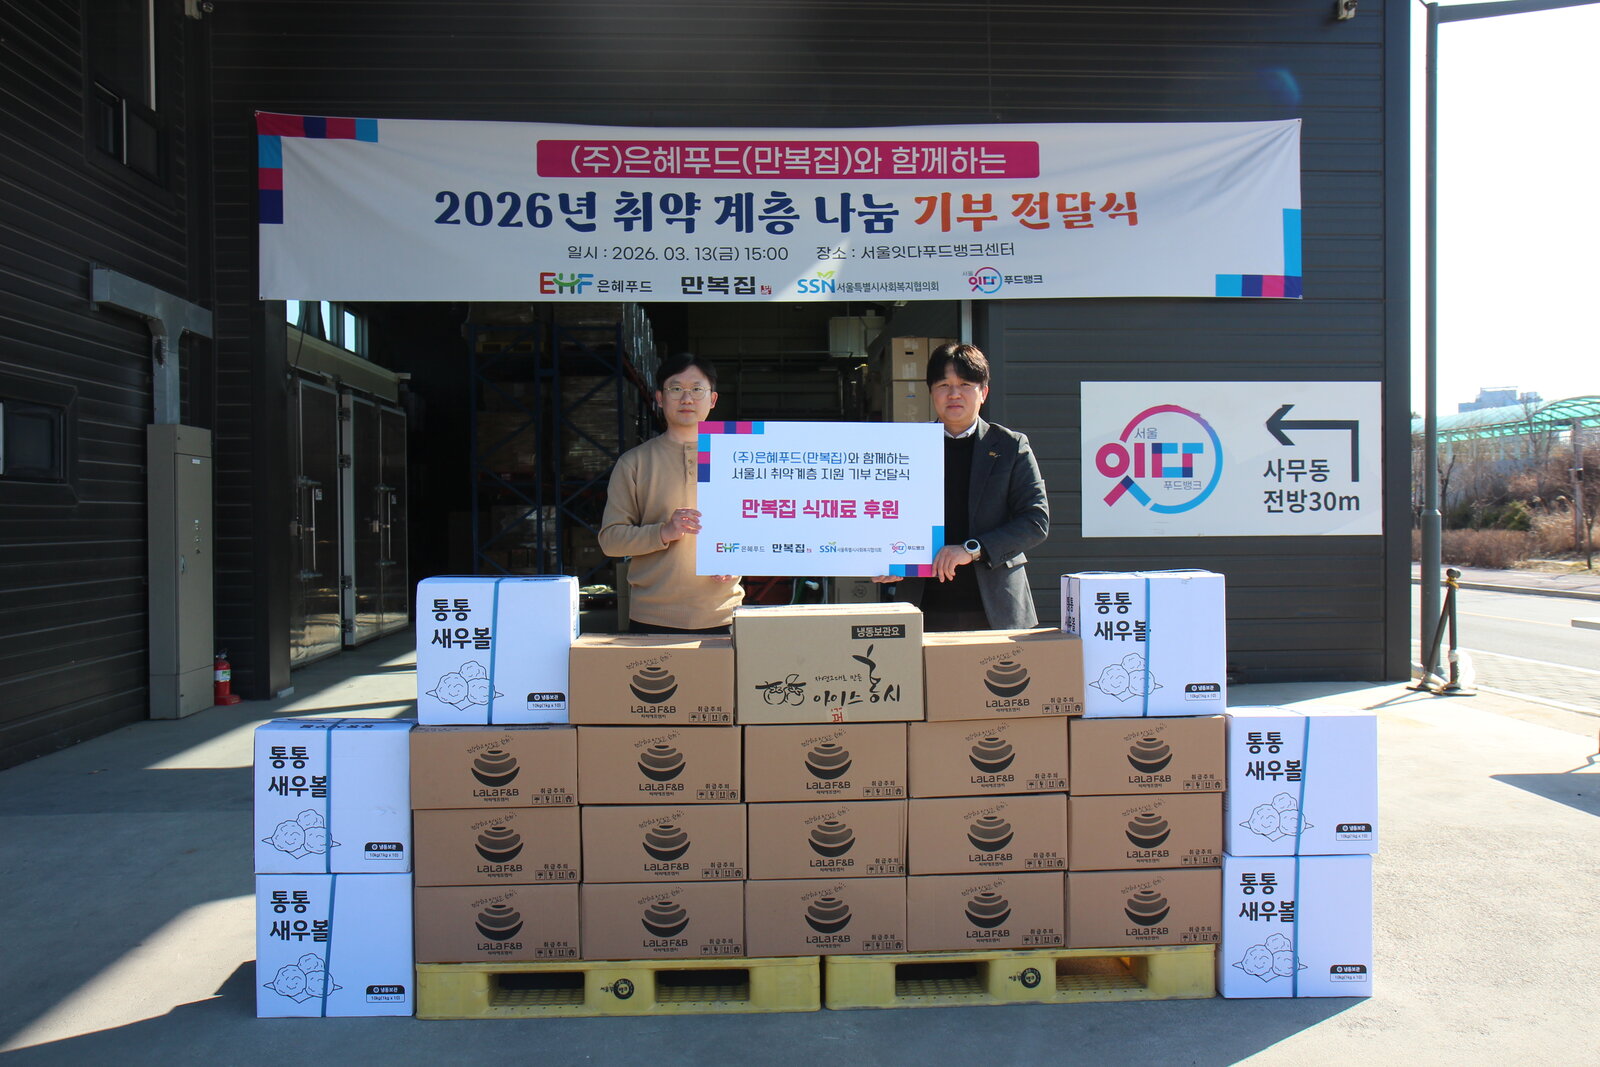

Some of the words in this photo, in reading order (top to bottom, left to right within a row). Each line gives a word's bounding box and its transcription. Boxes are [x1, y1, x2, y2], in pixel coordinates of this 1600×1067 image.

[571, 146, 882, 175] (주)은혜푸드(만복집)와
[892, 147, 1006, 175] 함께하는
[434, 191, 596, 232] 2026년
[614, 191, 701, 233] 취약
[714, 191, 800, 235] 계층
[815, 193, 899, 233] 나눔
[914, 192, 997, 232] 기부
[1011, 192, 1138, 230] 전달식
[568, 246, 597, 259] 일시
[613, 247, 658, 261] 2026.
[664, 247, 689, 261] 03.
[696, 247, 739, 261] 13(금)
[745, 247, 788, 261] 15:00
[817, 247, 847, 260] 장소
[861, 242, 1015, 260] 서울잇다푸드뱅크센터
[540, 272, 594, 294] EHF
[681, 276, 756, 295] 만복집
[797, 278, 836, 294] SSN
[1004, 274, 1043, 284] 푸드뱅크
[597, 280, 653, 294] 은혜푸드
[837, 281, 939, 293] 서울특별시사회복지협의회
[1134, 428, 1157, 439] 서울
[733, 451, 859, 465] (주)은혜푸드(만복집)와
[863, 452, 909, 465] 함께하는
[732, 467, 767, 480] 서울시
[771, 468, 817, 480] 취약계층
[821, 468, 844, 480] 지원
[850, 468, 871, 480] 기부
[875, 468, 910, 480] 전달식
[1263, 459, 1330, 482] 사무동
[1163, 480, 1202, 490] 푸드뱅크
[742, 499, 796, 519] 만복집
[803, 499, 857, 519] 식재료
[864, 499, 899, 519] 후원
[1263, 490, 1360, 514] 전방30m
[772, 543, 805, 553] 만복집
[820, 545, 837, 553] SSN
[432, 599, 471, 621] 통통
[1094, 592, 1132, 614] 통통
[1094, 620, 1151, 642] 새우볼
[432, 628, 492, 650] 새우볼
[631, 706, 656, 714] LaLa
[657, 706, 676, 714] F&B
[986, 698, 1010, 708] LaLa
[1012, 698, 1030, 706] F&B
[1246, 732, 1283, 754] 통통
[269, 746, 309, 768] 통통
[1246, 760, 1302, 781] 새우볼
[806, 782, 831, 790] LaLa
[833, 781, 850, 789] F&B
[971, 775, 995, 783] LaLa
[997, 774, 1015, 782] F&B
[268, 776, 326, 798] 새우볼
[473, 789, 499, 797] LaLa
[501, 788, 519, 796] F&B
[666, 783, 684, 791] F&B
[809, 859, 835, 868] LaLa
[836, 858, 854, 867] F&B
[969, 854, 993, 862] LaLa
[995, 853, 1013, 861] F&B
[477, 865, 503, 873] LaLa
[504, 864, 523, 872] F&B
[644, 863, 669, 872] LaLa
[670, 863, 689, 871] F&B
[1240, 873, 1277, 895] 통통
[271, 891, 310, 913] 통통
[1239, 901, 1294, 922] 새우볼
[270, 920, 328, 942] 새우볼
[966, 931, 991, 939] LaLa
[992, 929, 1010, 938] F&B
[1126, 928, 1150, 936] LaLa
[1151, 927, 1169, 935] F&B
[477, 943, 503, 951] LaLa
[504, 942, 523, 950] F&B
[643, 939, 668, 948] LaLa
[669, 939, 688, 947] F&B
[806, 936, 831, 944] LaLa
[832, 935, 850, 943] F&B
